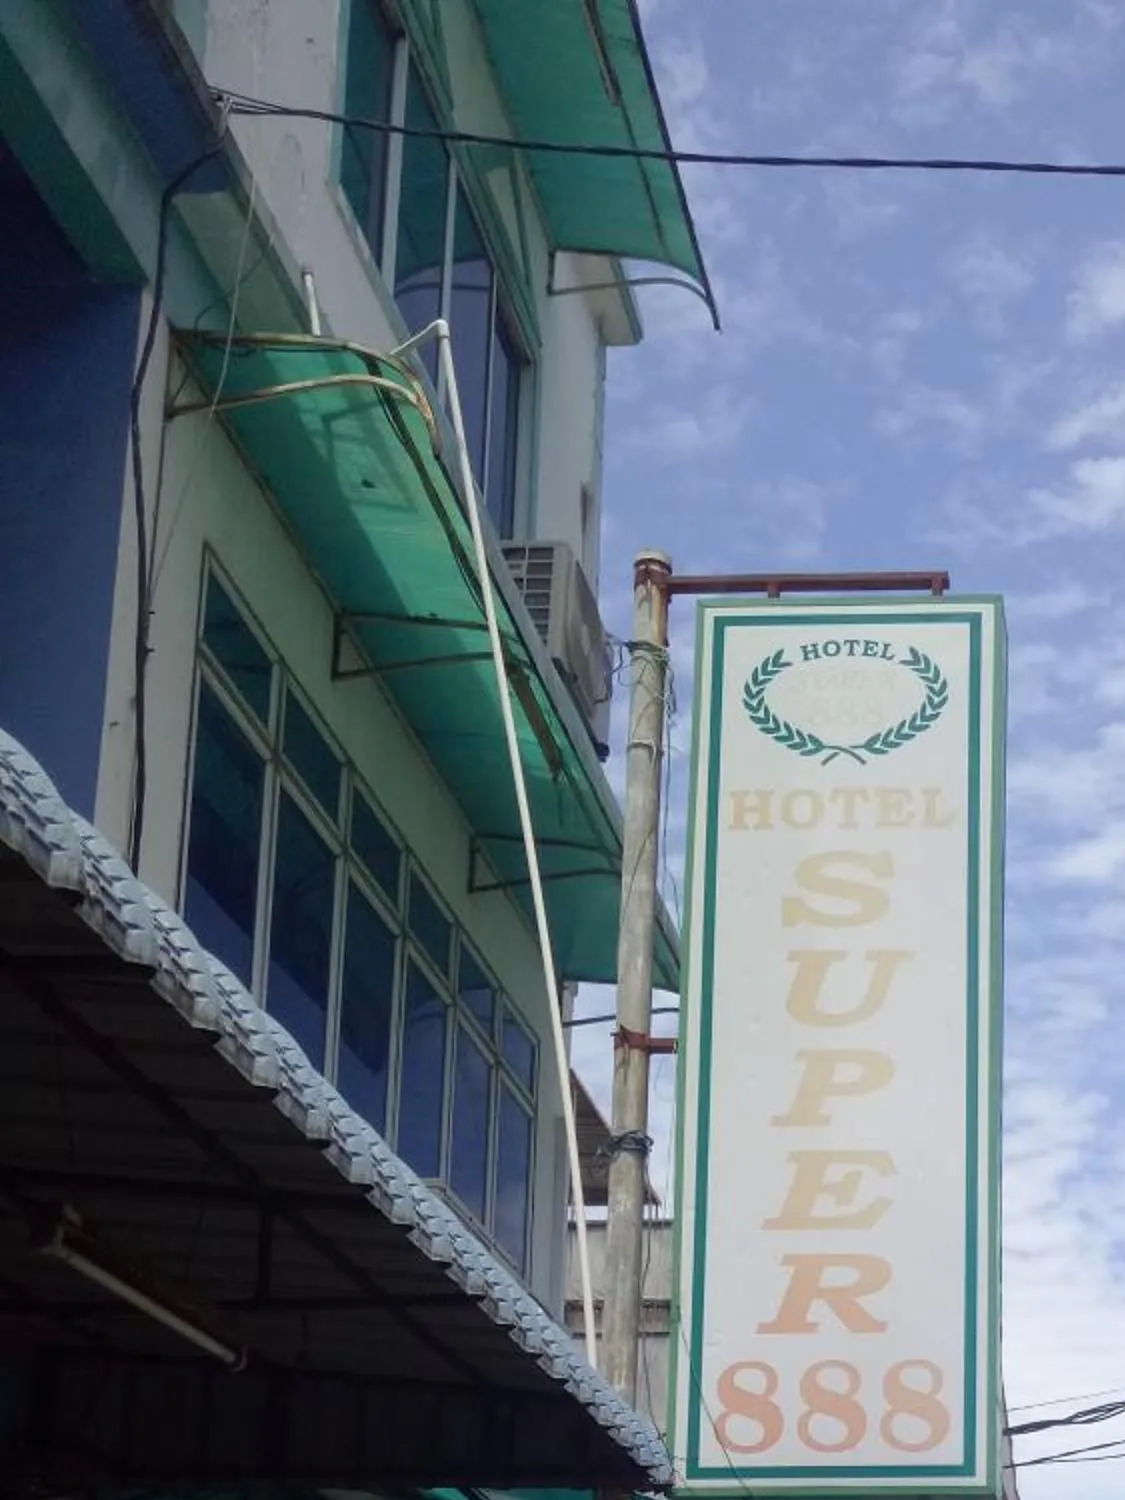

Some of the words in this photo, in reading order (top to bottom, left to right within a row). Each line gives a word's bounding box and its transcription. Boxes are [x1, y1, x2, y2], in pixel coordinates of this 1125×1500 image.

[799, 639, 895, 661] HOTEL
[728, 786, 955, 832] HOTEL
[715, 1359, 951, 1454] 888
